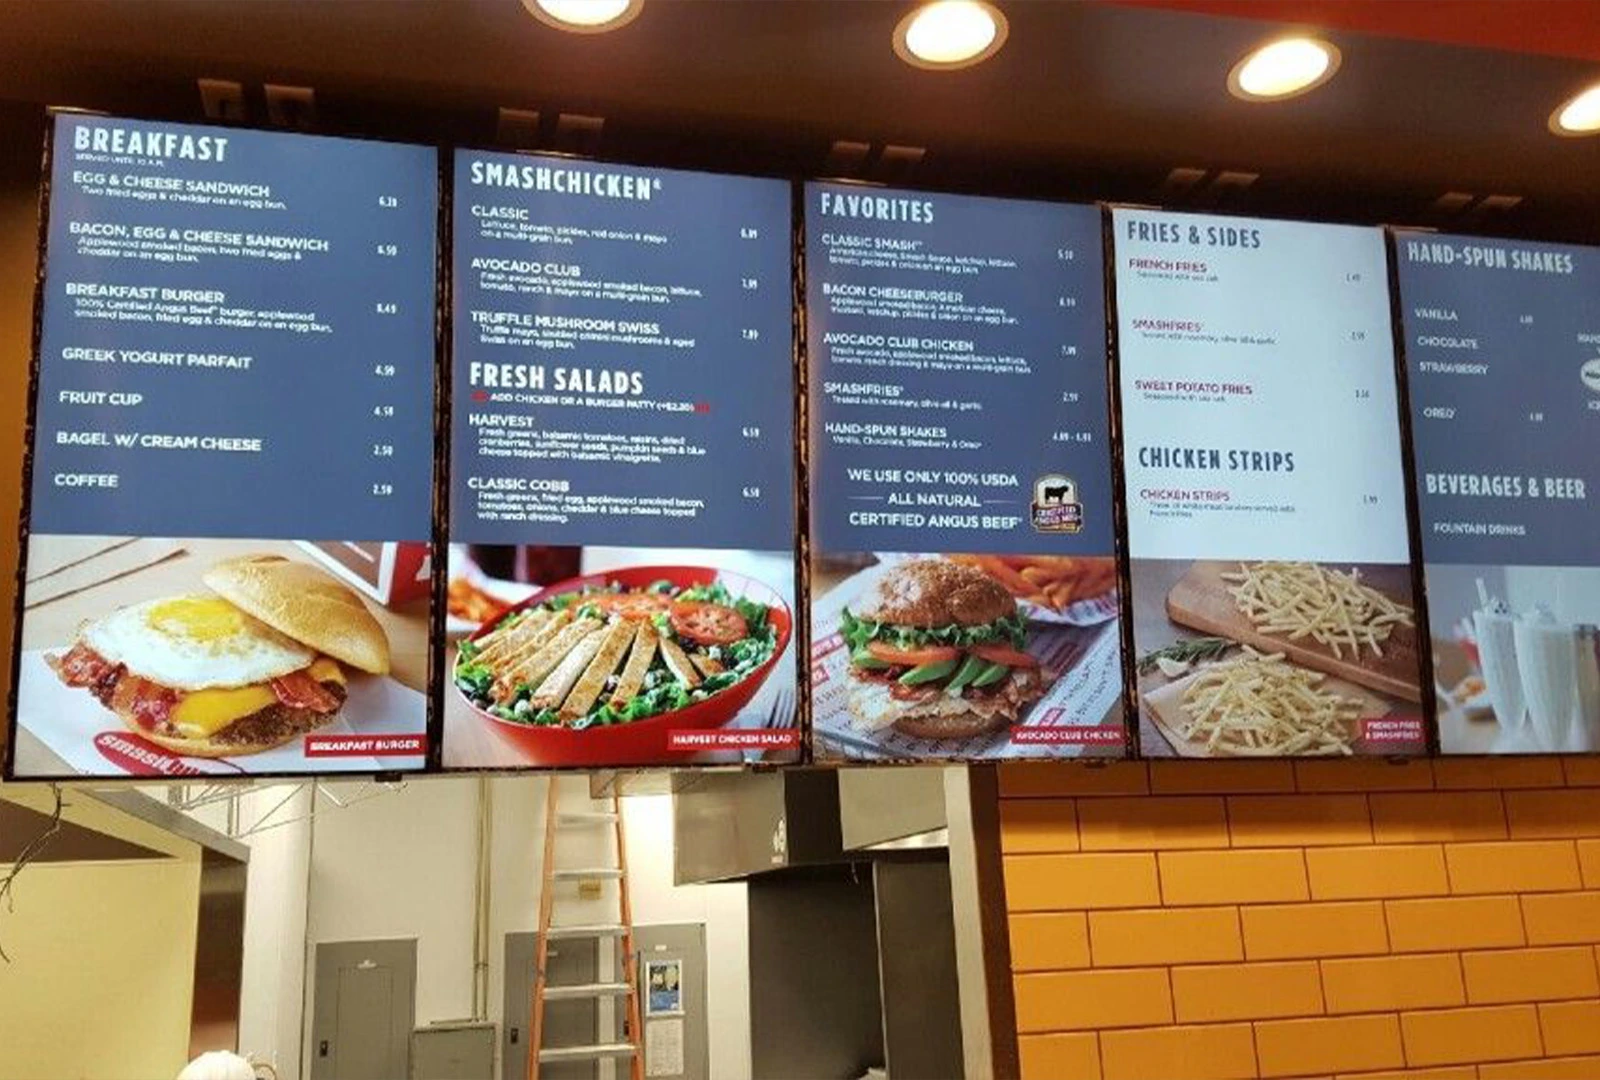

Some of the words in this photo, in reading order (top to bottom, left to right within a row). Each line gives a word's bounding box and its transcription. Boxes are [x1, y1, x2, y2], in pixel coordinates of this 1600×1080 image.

[75, 126, 228, 162] BREAKFAST
[73, 171, 106, 184] EGG
[109, 173, 120, 185] &
[123, 175, 184, 190] CHEESE
[186, 181, 270, 197] SANDWICH
[82, 185, 102, 196] Two
[471, 205, 529, 220] CLASSIC
[821, 192, 934, 224] FAVORITES
[69, 222, 130, 238] BACON,
[133, 227, 166, 239] EGG
[169, 229, 180, 240] &
[183, 230, 243, 245] CHEESE
[246, 234, 329, 251] SANDWICH
[821, 233, 872, 247] CLASSIC
[1127, 220, 1180, 243] FRIES
[1188, 225, 1200, 245] &
[1207, 226, 1261, 249] SIDES
[1129, 258, 1174, 271] FRENCH
[1175, 261, 1208, 273] FRIES
[1407, 242, 1507, 270] HAND-SPUN
[1512, 250, 1573, 274] SHAKES
[471, 257, 541, 273] AVOCADO
[544, 264, 581, 277] CLUB
[66, 282, 159, 299] BREAKFAST
[161, 288, 225, 303] BURGER
[823, 283, 866, 296] BACON
[868, 286, 963, 302] CHEESEBURGER
[470, 310, 532, 326] TRUFFLE
[535, 315, 615, 332] MUSHROOM
[618, 321, 660, 335] SWISS
[1414, 308, 1458, 321] VANILLA
[823, 333, 885, 346] AVOCADO
[887, 336, 919, 348] CLUB
[921, 339, 974, 352] CHICKEN
[1417, 335, 1479, 349] CHOCOLATE
[62, 347, 116, 363] GREEK
[119, 350, 184, 367] YOGURT
[187, 353, 253, 369] PARFAIT
[470, 362, 544, 389] FRESH
[554, 367, 643, 395] SALADS
[1135, 380, 1172, 391] SWEET
[1176, 382, 1219, 393] POTATO
[1222, 384, 1253, 395] FRIES
[59, 390, 106, 405] FRUIT
[108, 392, 143, 406] CUP
[490, 392, 513, 402] ADD
[514, 393, 558, 404] CHICKEN
[469, 414, 535, 427] HARVEST
[825, 422, 897, 436] HAND-SPUN
[899, 426, 947, 438] SHAKES
[56, 431, 110, 446] BAGEL
[114, 433, 138, 448] W/
[140, 435, 198, 449] CREAM
[200, 437, 263, 452] CHEESE
[1139, 446, 1220, 469] CHICKEN
[1228, 450, 1295, 472] STRIPS
[54, 473, 119, 488] COFFEE
[467, 477, 527, 490] CLASSIC
[529, 479, 570, 492] COBB
[847, 469, 872, 481] WE
[874, 470, 901, 483] USE
[904, 470, 941, 483] ONLY
[944, 472, 978, 485] 100%
[981, 473, 1019, 486] USDA
[1425, 473, 1522, 496] BEVERAGES
[1528, 477, 1539, 497] &
[1544, 478, 1586, 499] BEER
[887, 493, 914, 505] ALL
[917, 494, 982, 508] NATURAL
[1140, 488, 1190, 500] CHICKEN
[1192, 490, 1230, 502] STRIPS
[849, 512, 926, 526] CERTIFIED
[928, 515, 979, 528] ANGUS
[1433, 522, 1486, 535] FOUNTAIN
[673, 734, 716, 744] HARVEST
[718, 734, 759, 744] CHICKEN
[761, 734, 792, 743] SALAD
[1016, 730, 1059, 740] AVOCADO
[1060, 731, 1081, 740] CLUB
[1084, 730, 1120, 740] CHICKEN
[310, 741, 374, 751] BREAKFAST
[375, 740, 420, 750] BURGER
